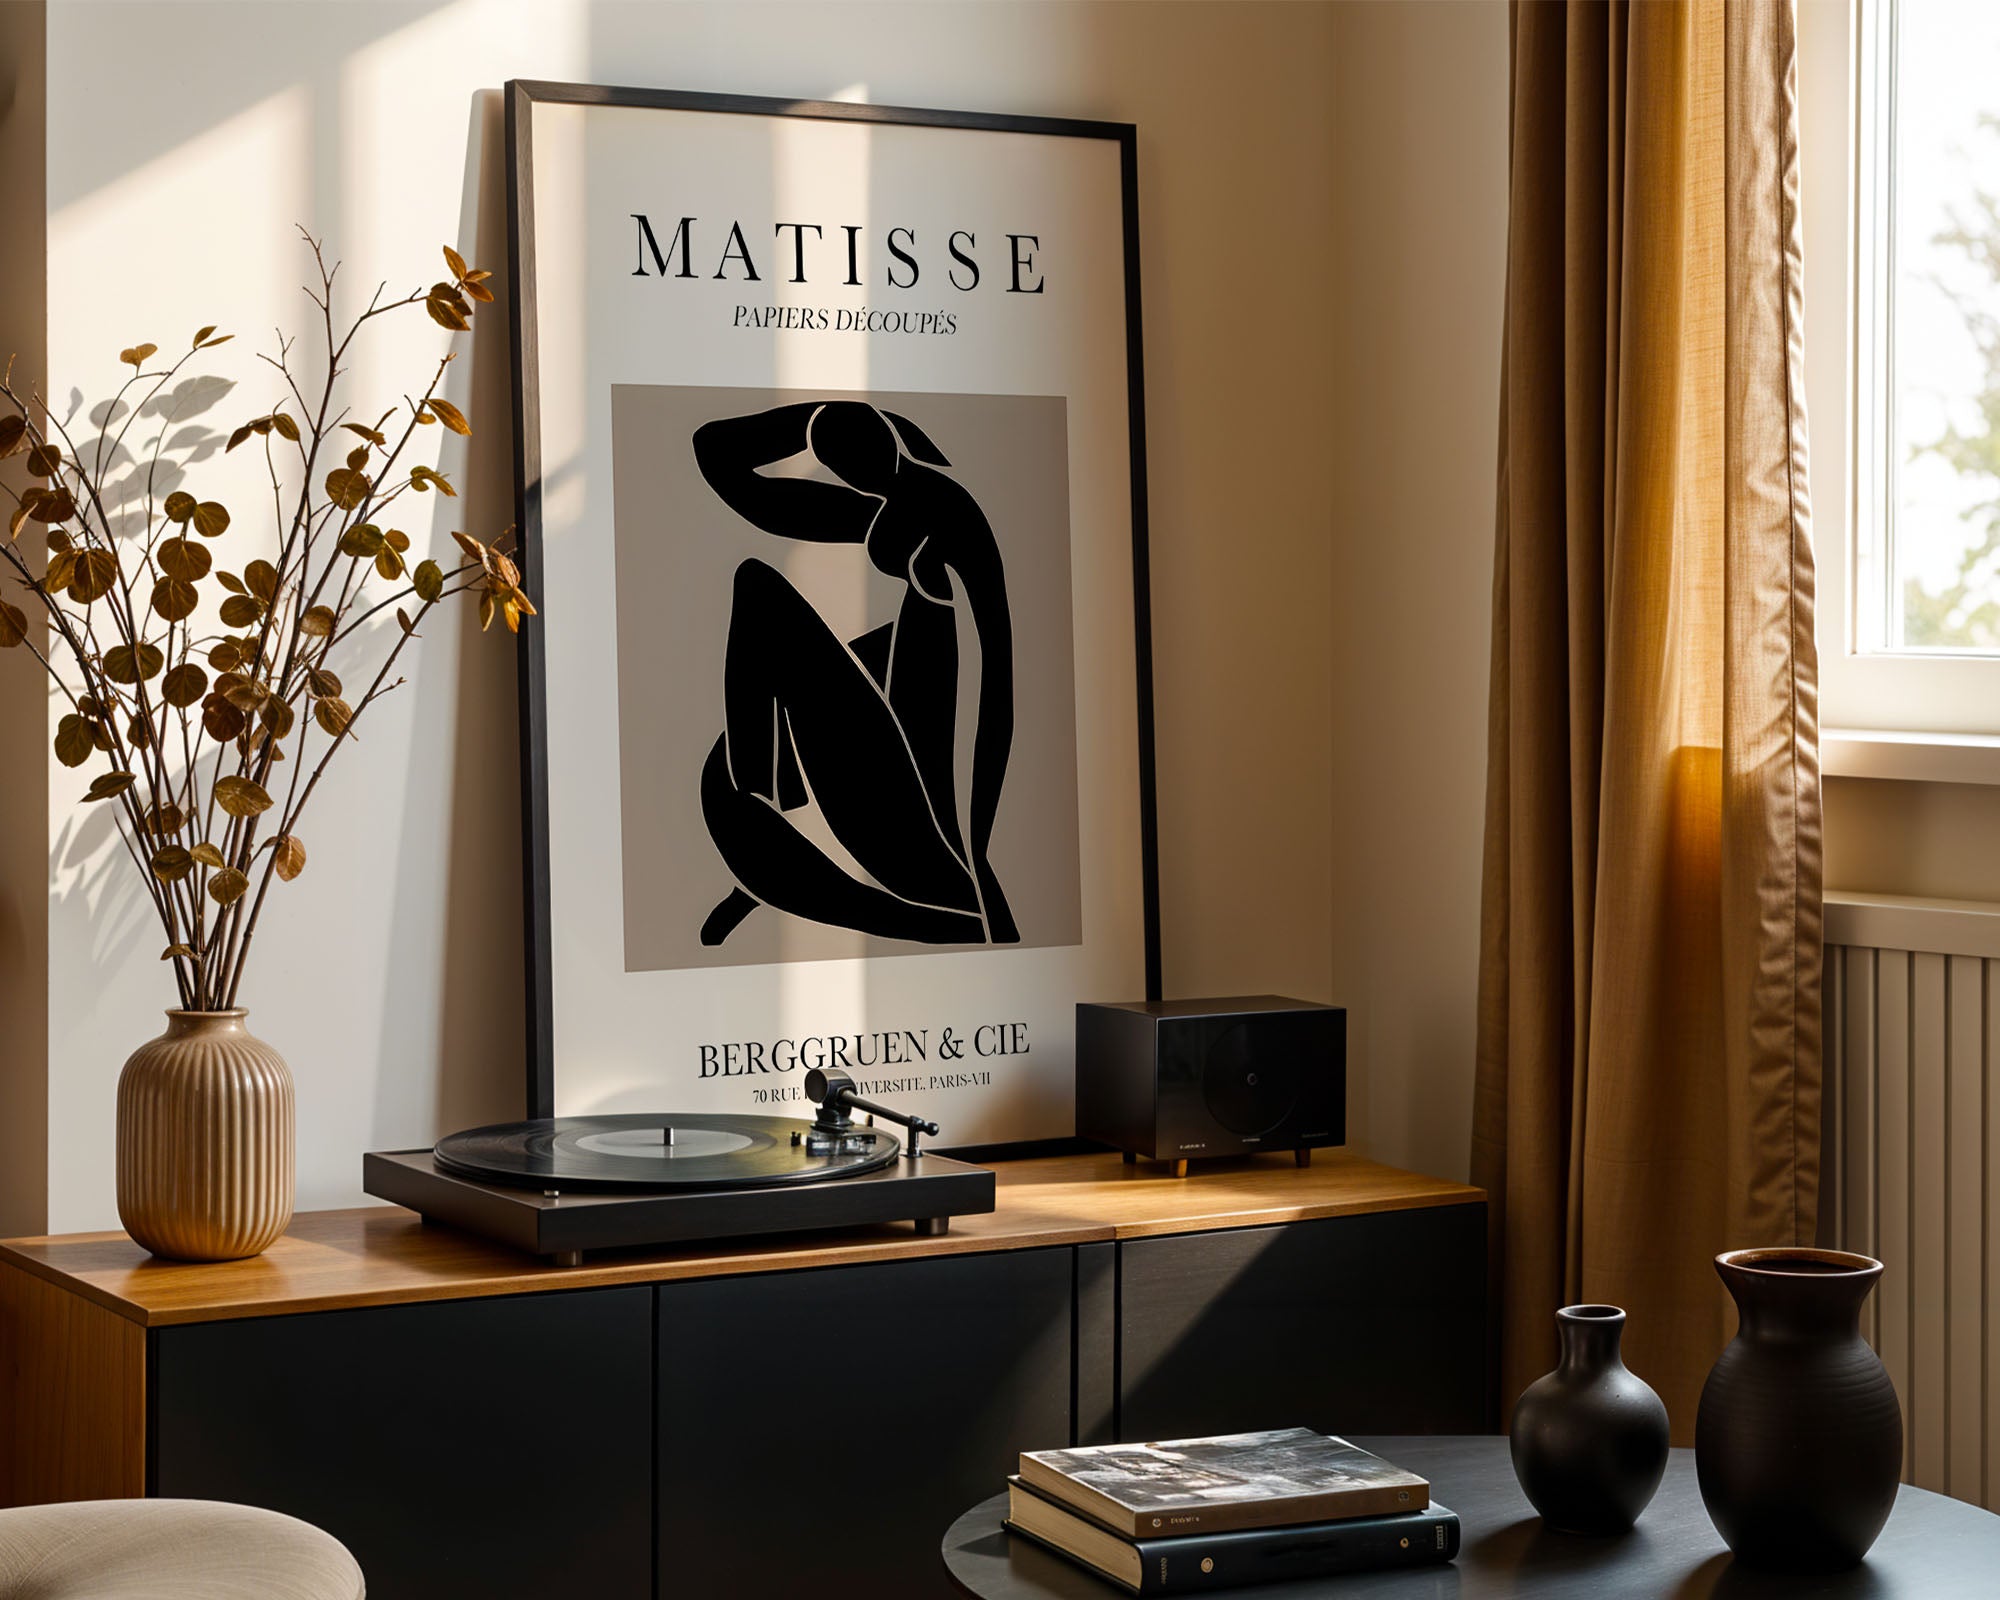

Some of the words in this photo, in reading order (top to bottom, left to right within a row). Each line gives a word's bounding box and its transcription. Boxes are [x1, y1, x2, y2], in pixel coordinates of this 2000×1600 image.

[630, 214, 1044, 294] MATISSE
[733, 306, 829, 331] PAPIERS
[834, 307, 957, 335] DÉCOUPÉS
[698, 1030, 929, 1078] BERGGRUEN
[939, 1027, 965, 1060] &
[973, 1023, 1031, 1056] CIE
[752, 1089, 768, 1104] 70
[770, 1087, 801, 1103] RUE
[929, 1072, 991, 1090] PARIS-VII
